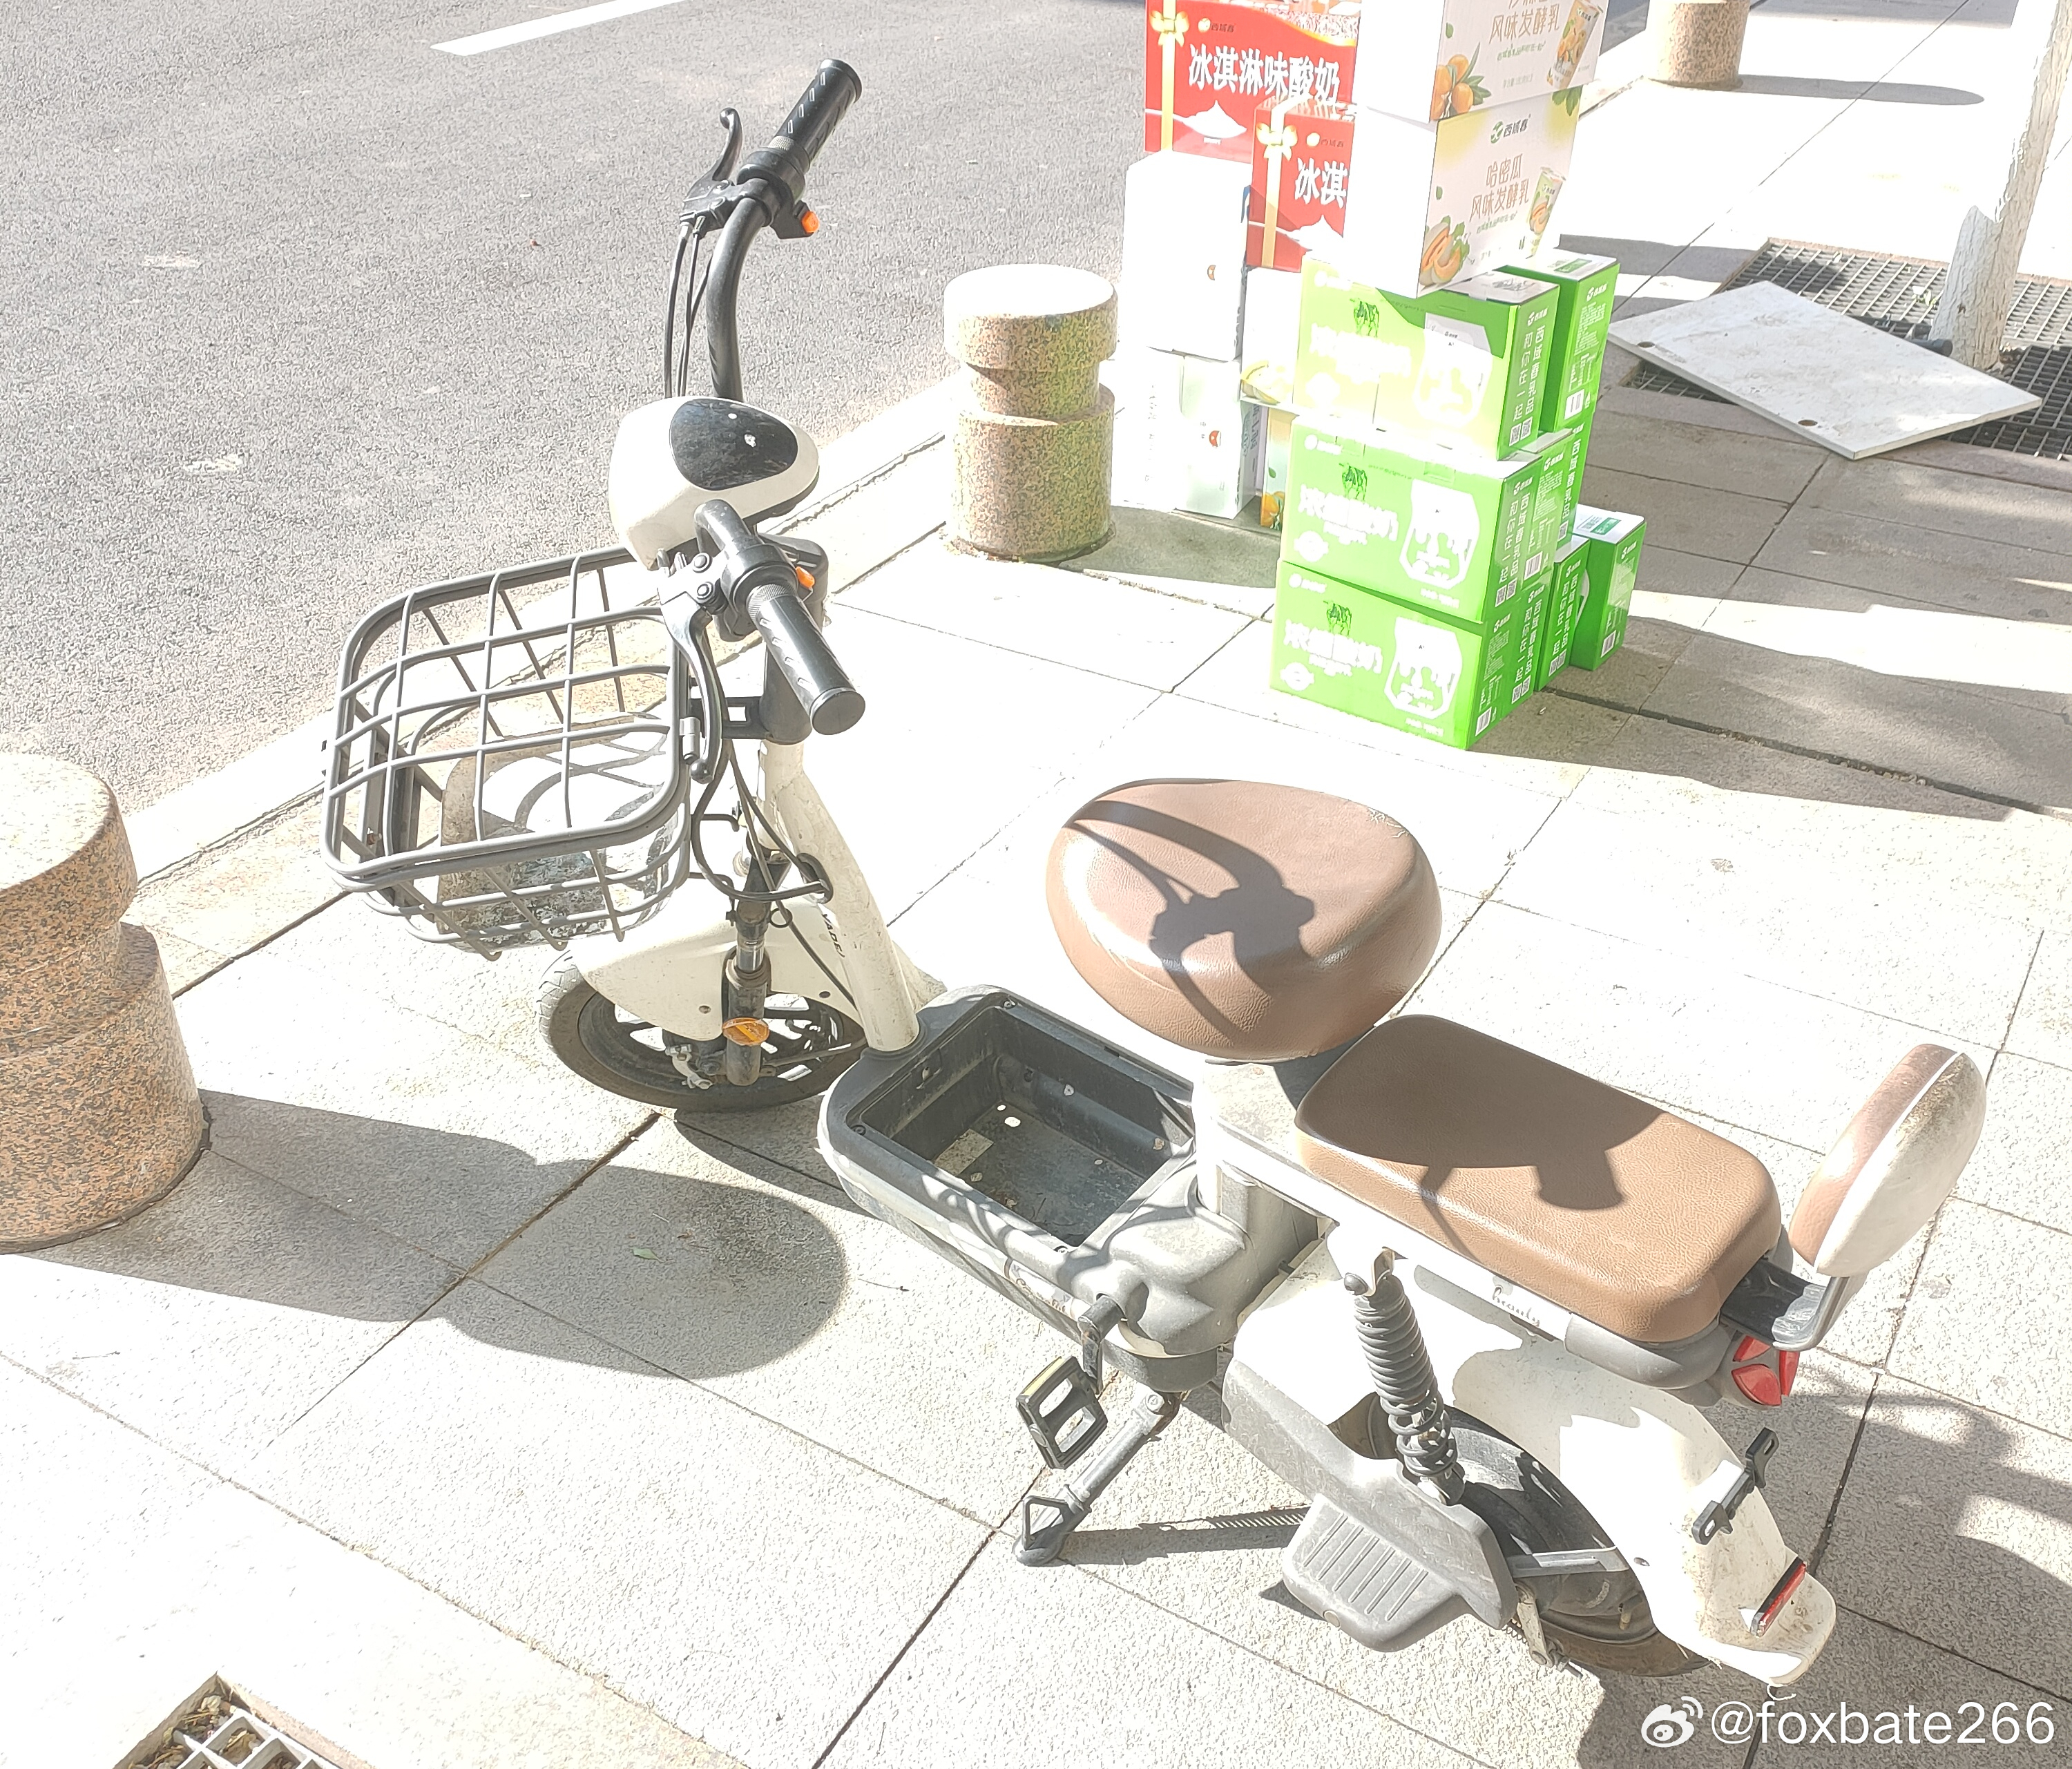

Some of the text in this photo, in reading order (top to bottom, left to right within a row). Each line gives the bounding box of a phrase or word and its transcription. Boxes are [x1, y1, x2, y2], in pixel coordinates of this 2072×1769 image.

[1489, 3, 1560, 44] 风味发酵乳
[1189, 44, 1341, 104] 冰淇淋味酸奶
[1503, 118, 1528, 138] 西域春
[1294, 157, 1348, 209] 冰淇
[1486, 153, 1523, 188] 哈密瓜
[1470, 178, 1529, 222] 风味发酵乳
[1513, 332, 1533, 421] 和你在一起
[1499, 500, 1519, 584] 和你在一起
